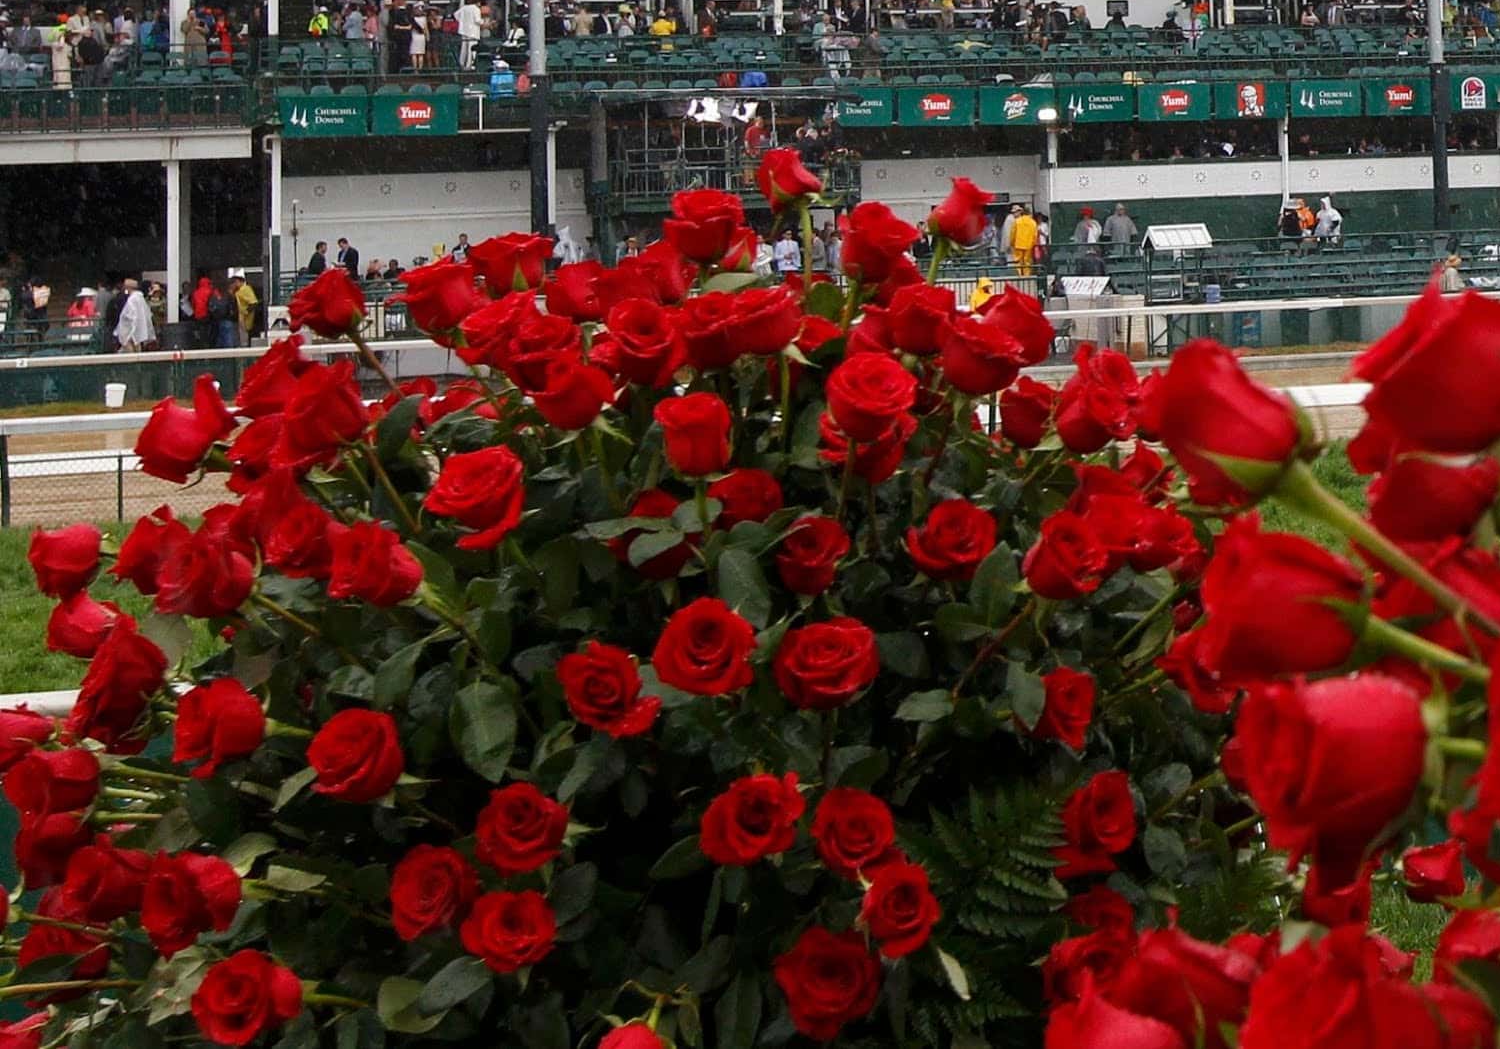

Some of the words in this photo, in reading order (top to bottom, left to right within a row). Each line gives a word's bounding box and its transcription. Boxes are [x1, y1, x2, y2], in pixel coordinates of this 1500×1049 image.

[1162, 94, 1188, 107] Yum!
[1386, 89, 1413, 101] Yum!
[922, 98, 950, 111] Yum!
[400, 106, 431, 119] Yum!
